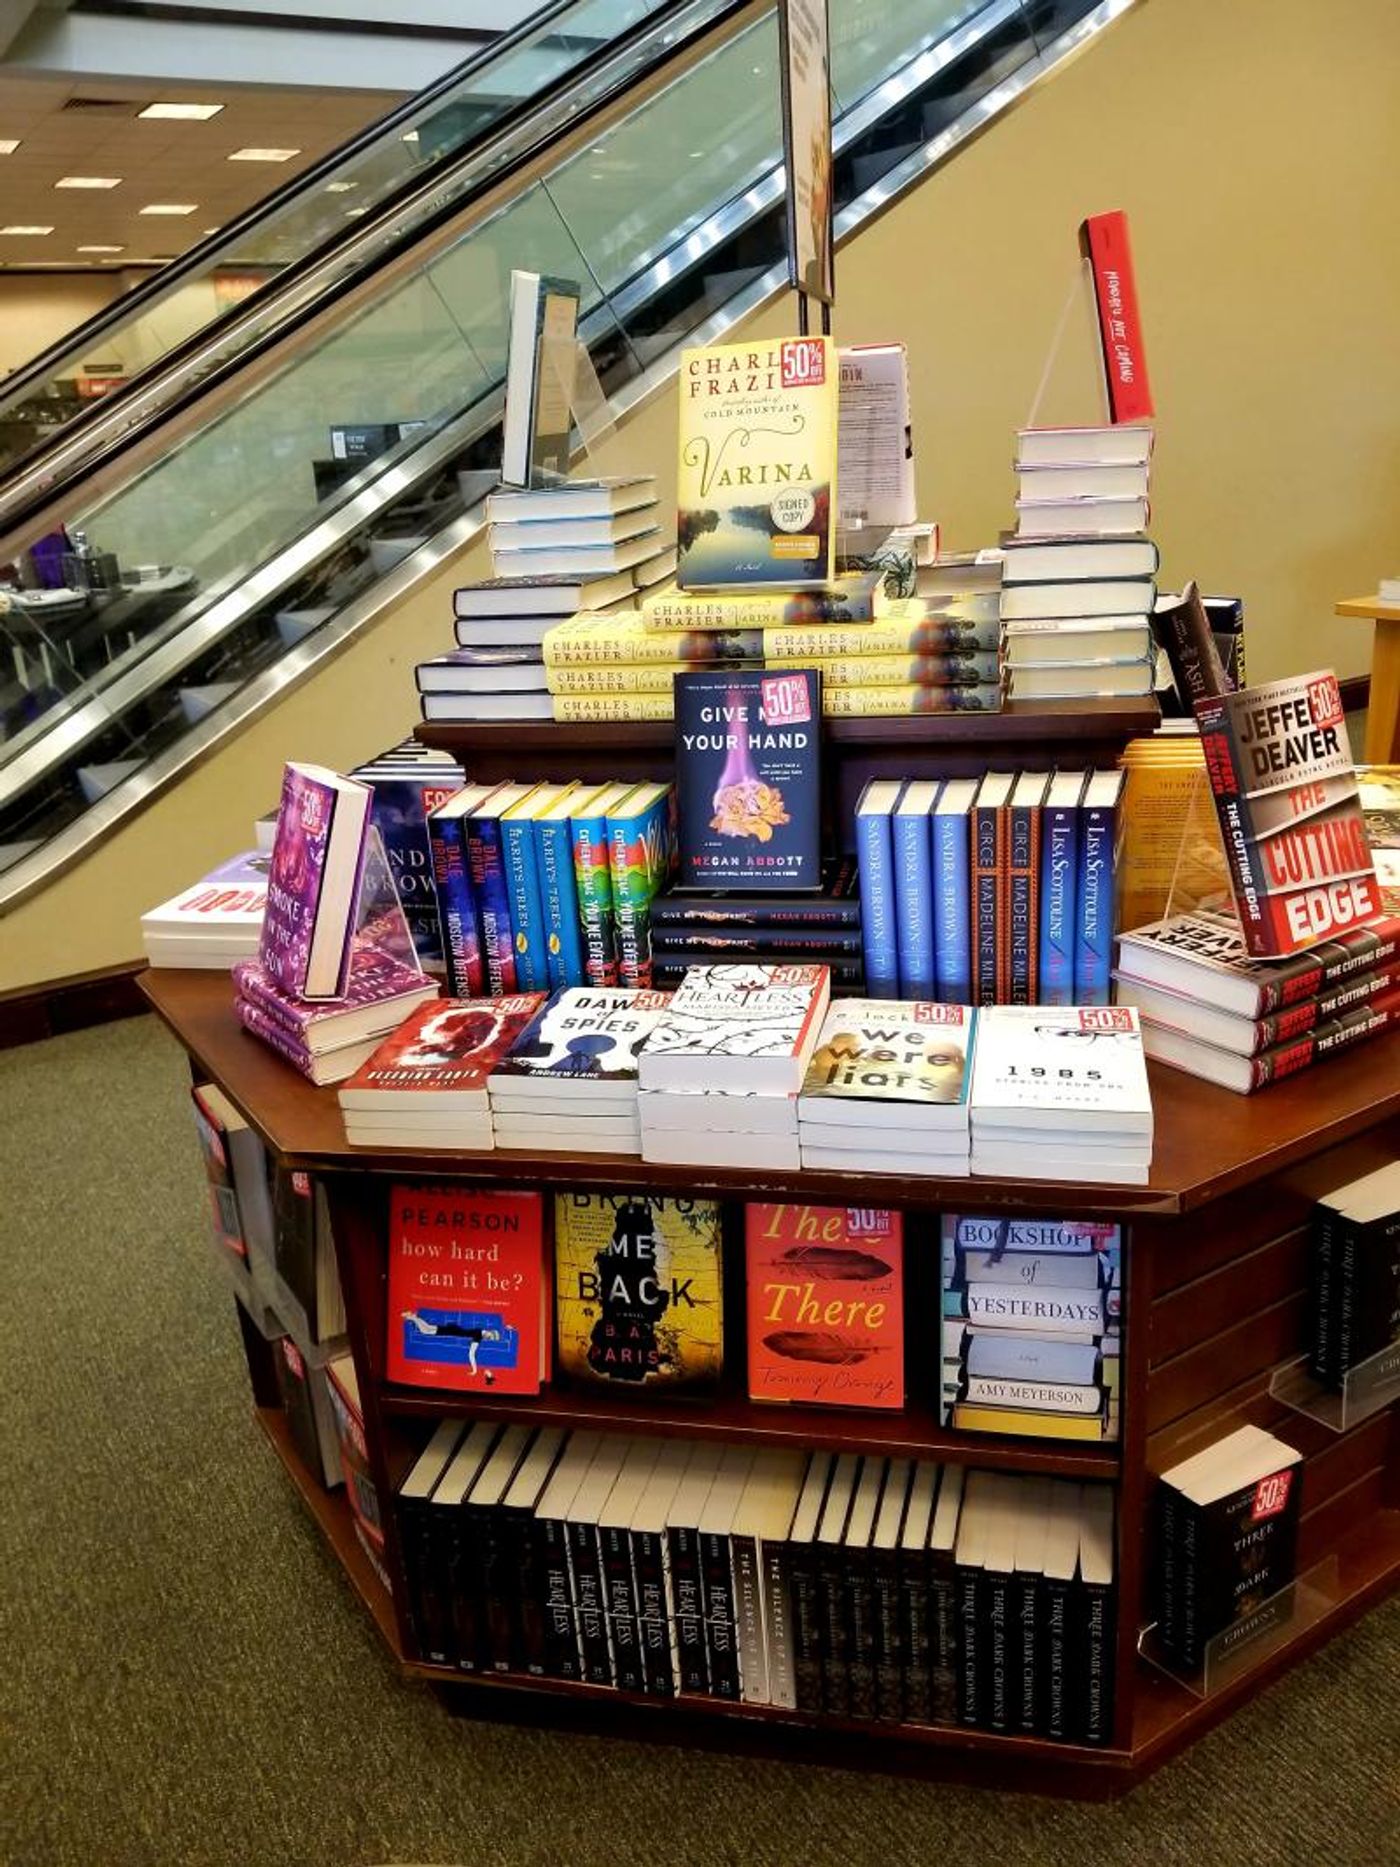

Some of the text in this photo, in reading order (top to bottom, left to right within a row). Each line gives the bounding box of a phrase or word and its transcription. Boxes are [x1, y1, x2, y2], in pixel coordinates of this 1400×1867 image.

[684, 428, 813, 497] VARINA
[778, 498, 809, 510] SIGNED
[782, 511, 804, 522] COPY
[653, 605, 724, 616] CHARLES
[653, 616, 725, 627] FRAZIER
[552, 641, 621, 652] CHARLES
[775, 634, 848, 646] CHARLES
[775, 646, 848, 657] FRAZIER
[553, 652, 622, 663] FRAZIER
[556, 671, 624, 683] CHARLES
[558, 682, 627, 692] FRAZIER
[563, 701, 630, 712] CHARLES
[701, 707, 749, 722] GIVE
[683, 733, 808, 750] YOUR HAND
[1251, 727, 1340, 777] DEAVER
[1288, 783, 1327, 817] THE
[868, 821, 881, 881] SANDRA
[904, 822, 918, 882] SANDRA
[979, 820, 994, 866] CIRCE
[1051, 827, 1070, 857] LISA
[1087, 826, 1105, 858] LISA
[1264, 820, 1373, 888] CUTTING
[432, 838, 449, 884] BROWN
[447, 844, 464, 878] DALE
[469, 838, 486, 884] BROWN
[483, 844, 500, 878] DALE
[692, 856, 803, 867] MEGAN ABBOTT
[1227, 803, 1262, 920] THE CUTTING EDGE
[942, 822, 957, 941] SANDRA BROWN
[1013, 820, 1029, 955] CIRCE MADELINE
[269, 884, 300, 922] SMOKE
[516, 887, 528, 928] TREES
[549, 888, 561, 929] TREES
[586, 900, 600, 922] YOU
[619, 900, 634, 923] YOU
[871, 887, 885, 940] BROWN
[906, 888, 920, 942] BROWN
[979, 878, 994, 953] MADELINE
[1285, 879, 1374, 944] EDGE
[276, 926, 291, 949] THE
[448, 911, 464, 958] MOSCOW
[483, 911, 498, 958] MOSCOW
[265, 948, 284, 977] SUN
[1326, 942, 1396, 979] THE CUTTING EDGE
[575, 998, 632, 1011] DAW
[678, 990, 804, 1007] HEARTLESS
[1321, 999, 1336, 1014] THE
[1337, 984, 1370, 1006] CUTTING
[1370, 975, 1391, 991] EDGE
[560, 1017, 640, 1032] SPIES
[916, 1004, 963, 1024] 50%
[1083, 1009, 1133, 1031] 50%
[862, 1027, 926, 1045] we
[1318, 1012, 1388, 1051] THE CUTTING EDGE
[829, 1046, 952, 1067] were
[528, 1068, 600, 1080] ANDREW LANE
[826, 1064, 940, 1091] liars
[1007, 1065, 1103, 1081] 1985
[402, 1207, 521, 1233] PEARSON
[963, 1224, 1088, 1248] BOOKSHOP
[402, 1237, 500, 1262] how hard
[608, 1233, 654, 1259] ME
[419, 1270, 524, 1292] can it be?
[1021, 1261, 1041, 1285] of
[578, 1271, 696, 1309] BACK
[763, 1282, 886, 1329] There
[968, 1296, 1101, 1322] YESTERDAYS
[592, 1348, 660, 1365] PARIS
[976, 1383, 1084, 1405] AMY MEYERSON
[1234, 1522, 1275, 1551] THREE
[770, 1557, 784, 1638] THE SILENCE
[1234, 1568, 1269, 1596] DARK
[546, 1570, 571, 1636] HEARTLESS
[578, 1575, 603, 1638] HEARTLESS
[609, 1579, 635, 1645] HEARTLESS
[637, 1583, 666, 1649] HEARTLESS
[675, 1579, 701, 1645] HEARTLESS
[962, 1584, 975, 1619] THREE
[991, 1590, 1004, 1627] THREE
[1020, 1588, 1035, 1625] THREE
[1049, 1598, 1064, 1633] THREE
[706, 1585, 733, 1652] HEARTLESS
[1088, 1599, 1102, 1637] THREE
